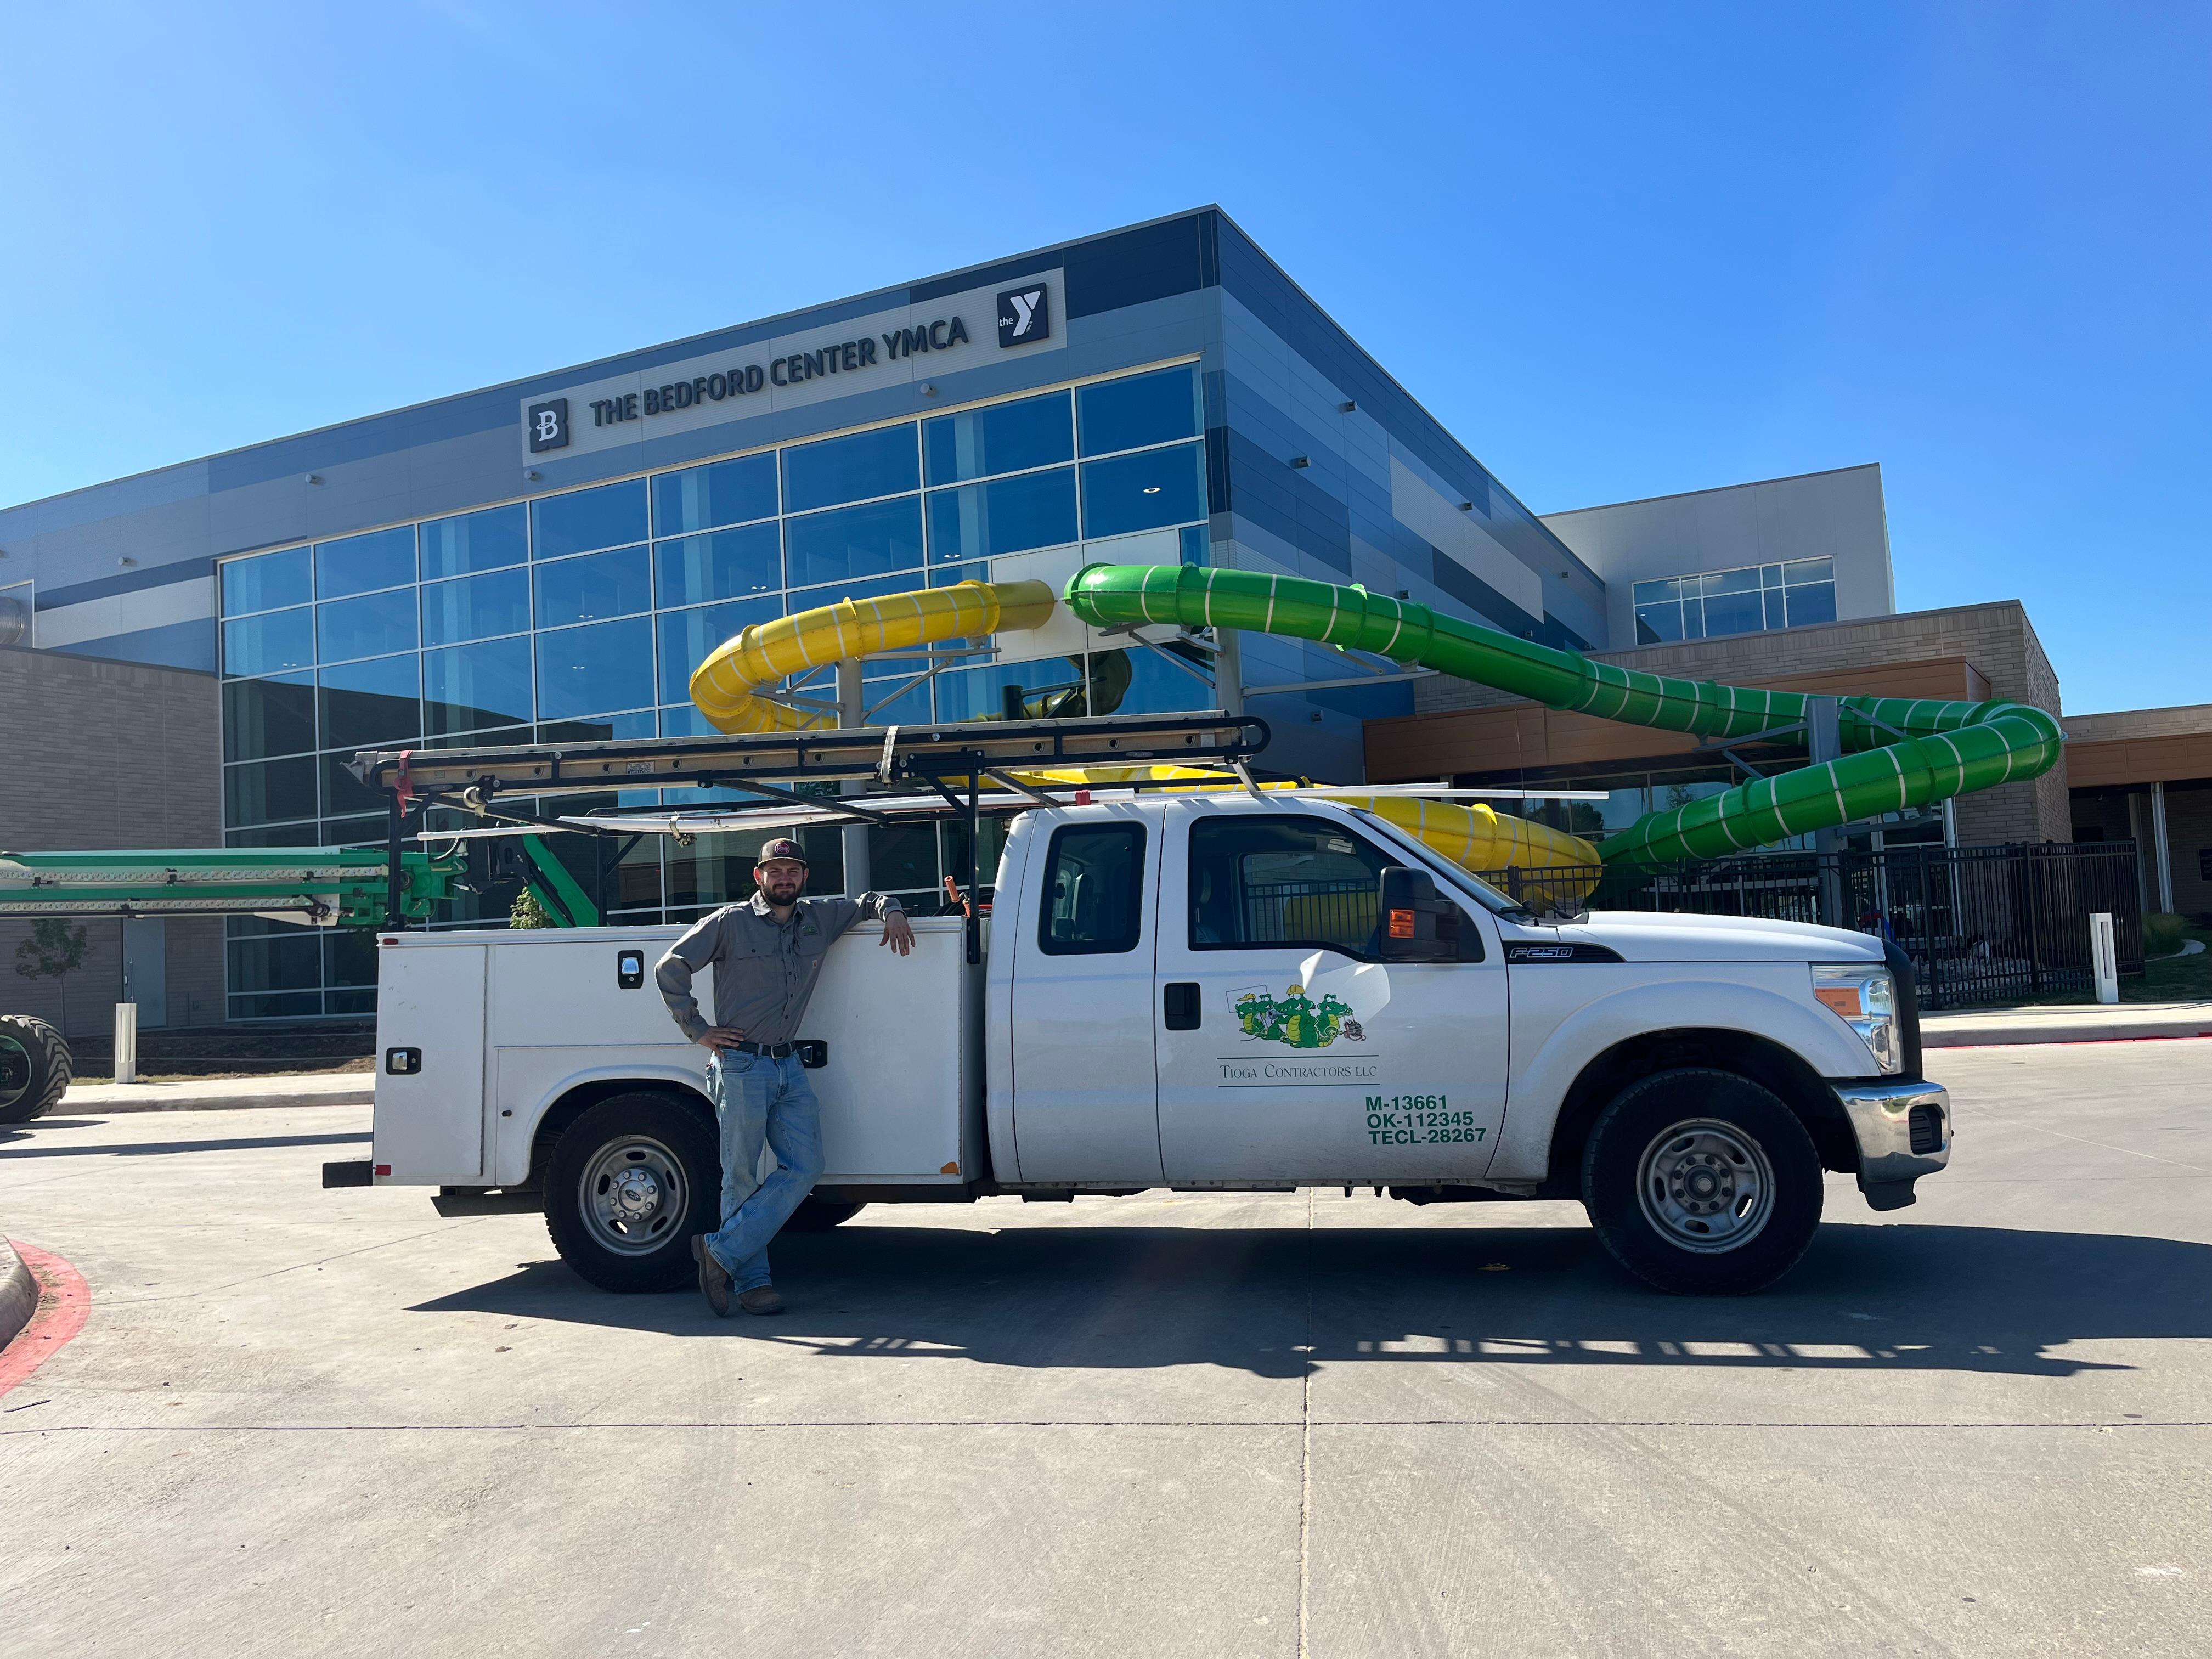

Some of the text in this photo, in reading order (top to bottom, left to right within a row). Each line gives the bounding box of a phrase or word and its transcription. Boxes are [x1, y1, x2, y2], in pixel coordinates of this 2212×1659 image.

[999, 317, 1013, 326] the
[589, 317, 969, 426] THE BEDFORD CENTER YMCA
[535, 410, 559, 441] B
[1509, 947, 1573, 958] F-250
[1356, 1066, 1378, 1076] LLC
[1365, 1095, 1447, 1111] M-13661
[1367, 1111, 1474, 1128] OK-112345
[1368, 1128, 1486, 1145] TECL-28267
